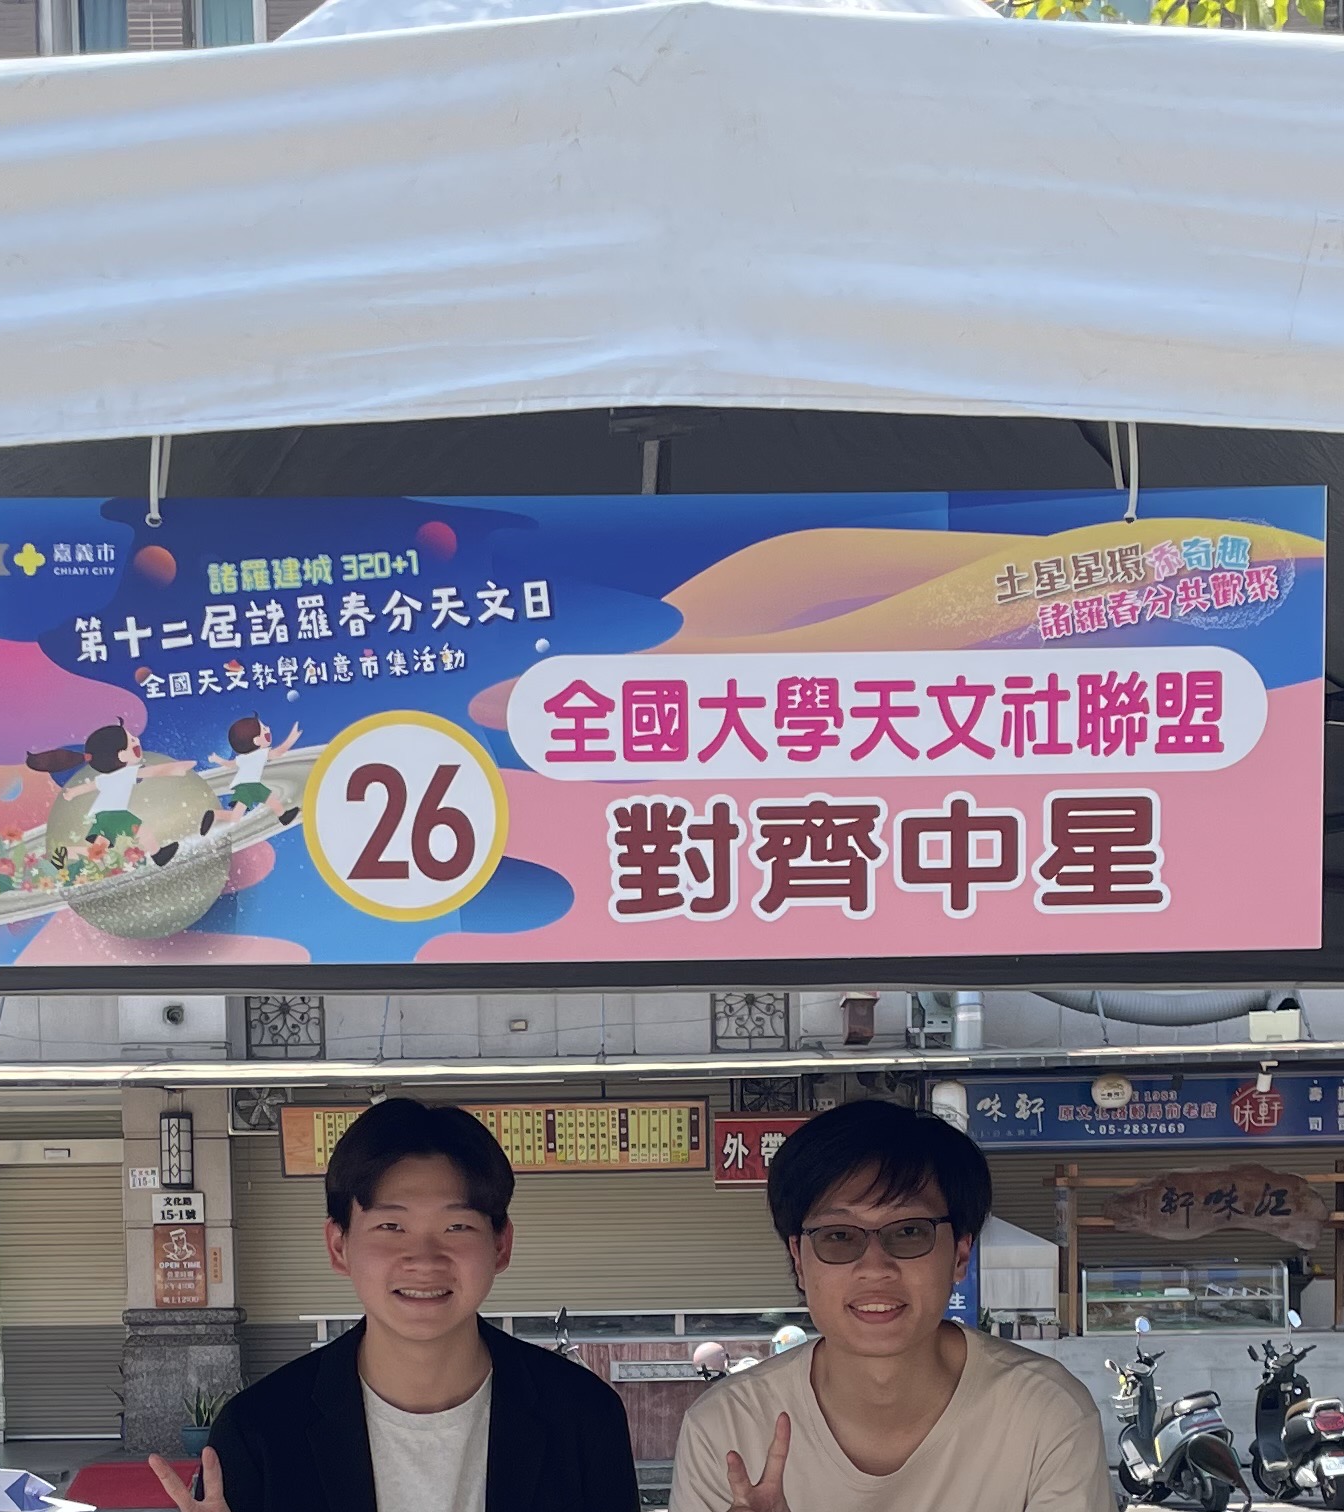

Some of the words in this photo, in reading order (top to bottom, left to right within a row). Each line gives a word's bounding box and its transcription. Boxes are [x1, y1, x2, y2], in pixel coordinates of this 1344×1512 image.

[53, 543, 115, 564] 嘉義市
[53, 566, 88, 576] CHIAYI
[91, 566, 116, 576] CITY
[208, 556, 334, 595] 諸羅建城
[340, 549, 420, 585] 320+1
[994, 534, 1251, 603] 土星星環添奇趣
[74, 580, 552, 664] 第十二屆諸羅春分天文日
[1037, 565, 1280, 641] 諸羅春分共歡聚
[140, 642, 467, 700] 全國天文教學創意市集活動
[542, 670, 1225, 764] 全國大學天文社聯盟
[345, 763, 476, 881] 26
[612, 794, 1165, 916] 對齊中星
[1098, 1123, 1186, 1136] 05-2837669
[160, 1209, 197, 1220] 15-1號
[163, 1196, 193, 1206] 文化路
